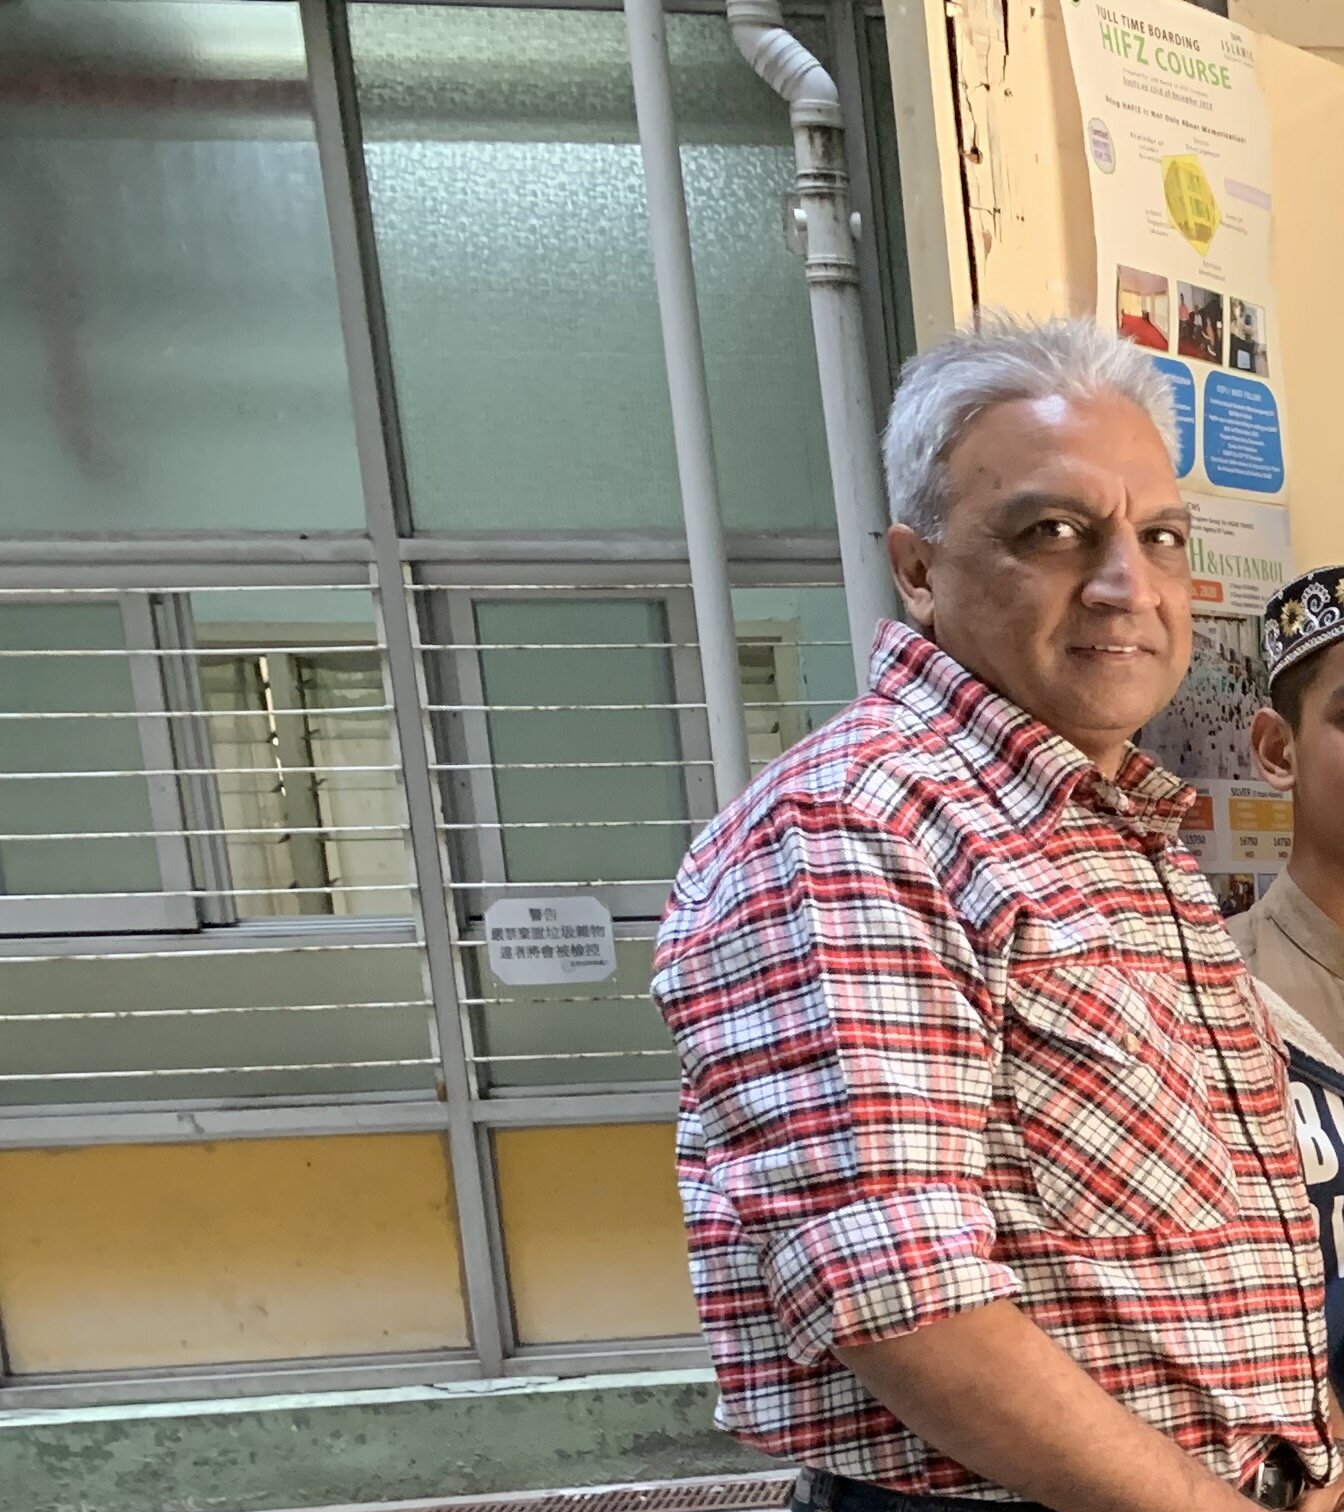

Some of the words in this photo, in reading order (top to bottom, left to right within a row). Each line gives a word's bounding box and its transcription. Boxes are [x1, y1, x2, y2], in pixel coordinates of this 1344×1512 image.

[1099, 20, 1149, 66] HIFZ
[1155, 47, 1233, 91] COURSE
[1121, 15, 1146, 34] TIME
[1148, 23, 1201, 52] BOARDING
